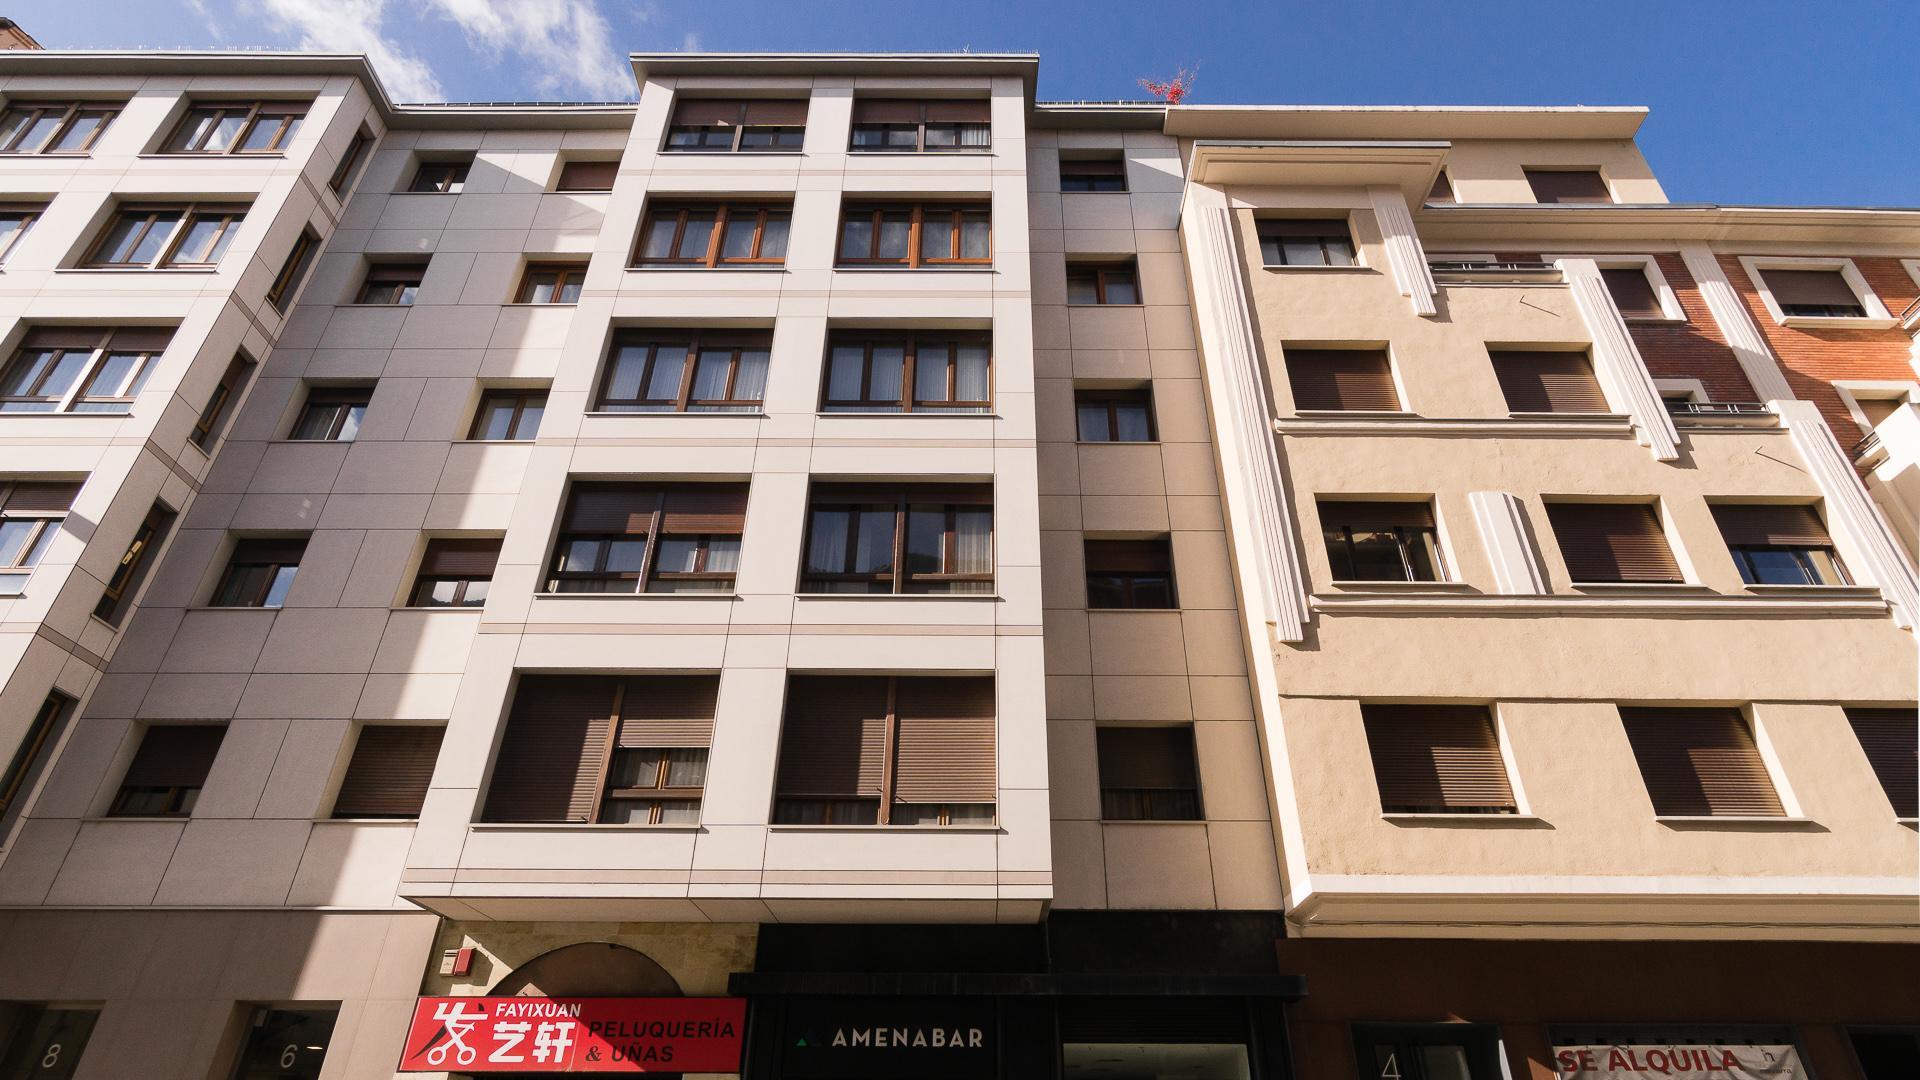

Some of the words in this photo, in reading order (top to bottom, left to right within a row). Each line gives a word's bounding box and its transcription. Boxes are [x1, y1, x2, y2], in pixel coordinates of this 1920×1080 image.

[495, 1003, 581, 1017] FAYIXUAN
[588, 1018, 735, 1038] PELUQUERÍA
[831, 1028, 984, 1047] AMENABAR
[42, 1044, 61, 1068] 8
[280, 1044, 298, 1068] 6
[585, 1046, 602, 1062] &
[611, 1042, 674, 1062] UÑAS
[1558, 1049, 1598, 1072] SE
[1608, 1049, 1745, 1075] ALQUILA
[1382, 1053, 1402, 1080] 4
